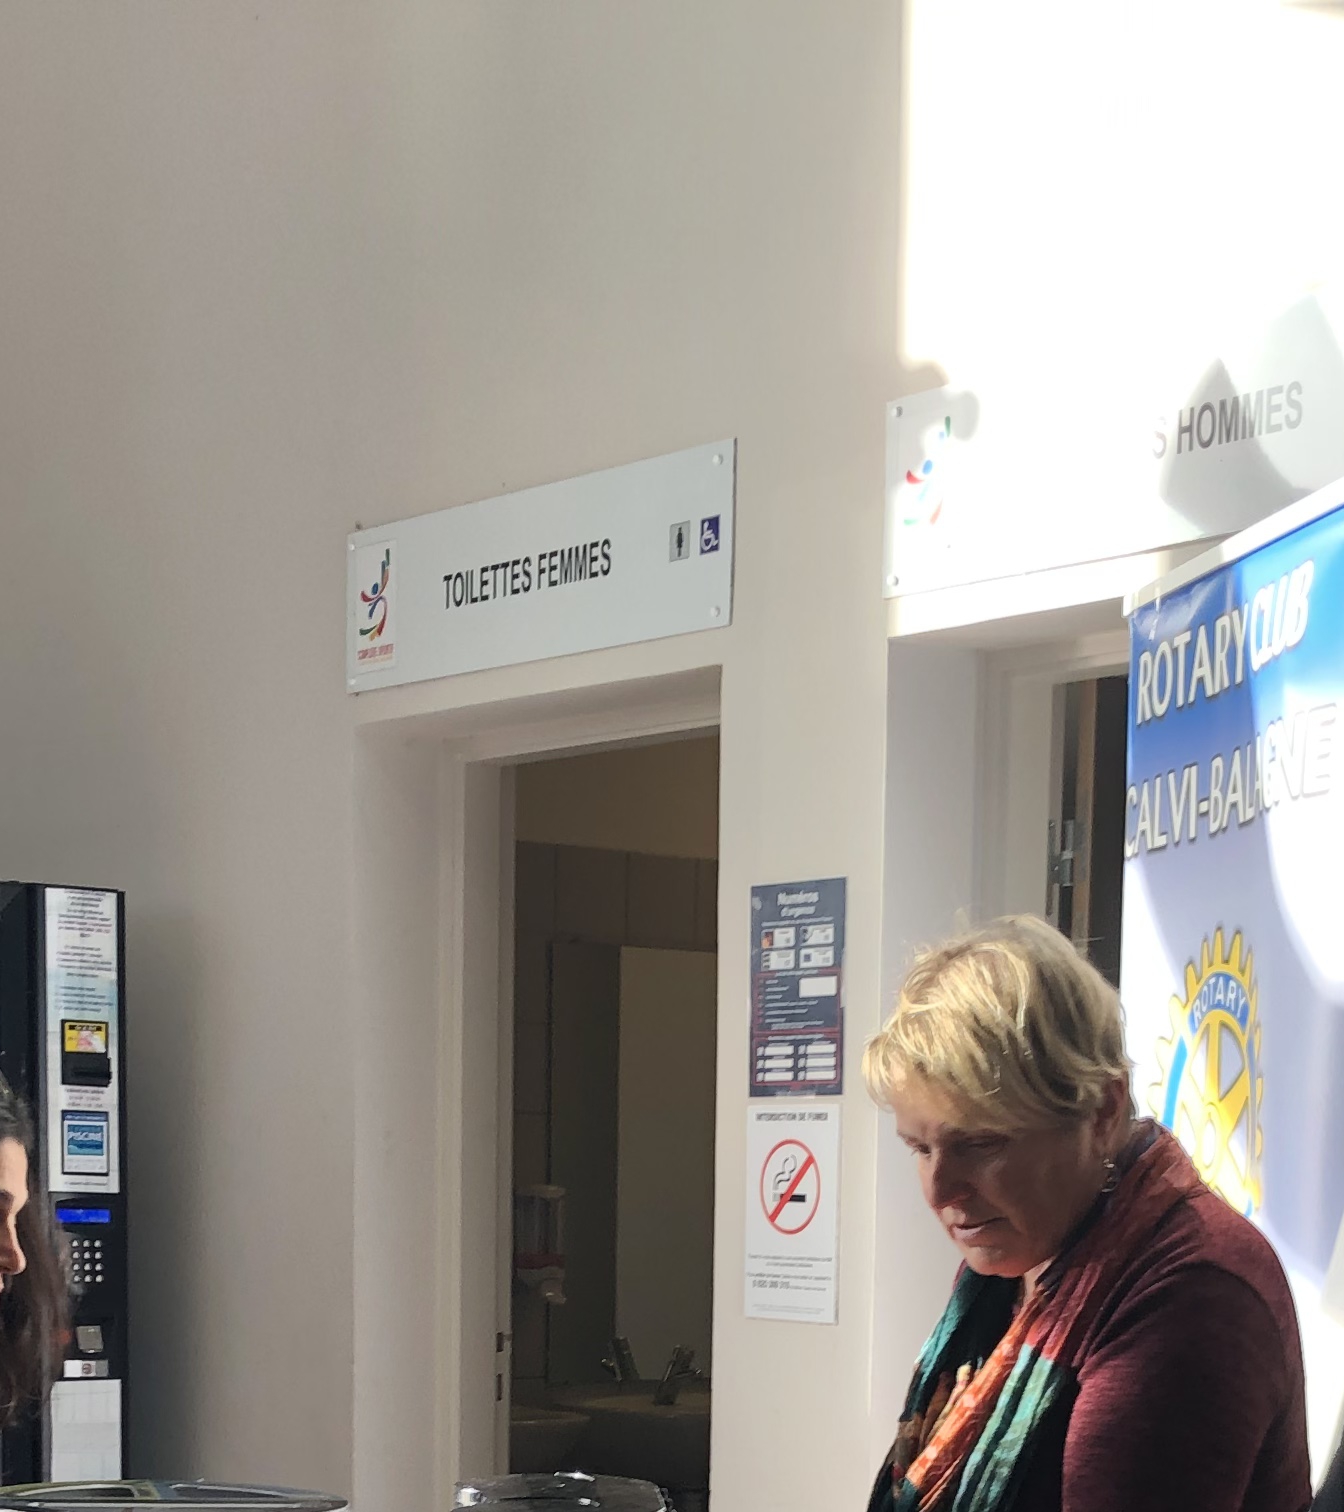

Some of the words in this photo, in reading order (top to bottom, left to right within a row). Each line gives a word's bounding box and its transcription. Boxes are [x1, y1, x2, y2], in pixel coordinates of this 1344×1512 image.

[1177, 380, 1303, 455] HOMMES
[443, 557, 533, 610] TOILETTES
[537, 538, 612, 590] FEMMES
[1136, 601, 1249, 727] ROTARY
[1249, 559, 1315, 672] CLUB
[1124, 702, 1338, 860] CALVI-BALAGNE
[1192, 975, 1247, 1028] ROTARY
